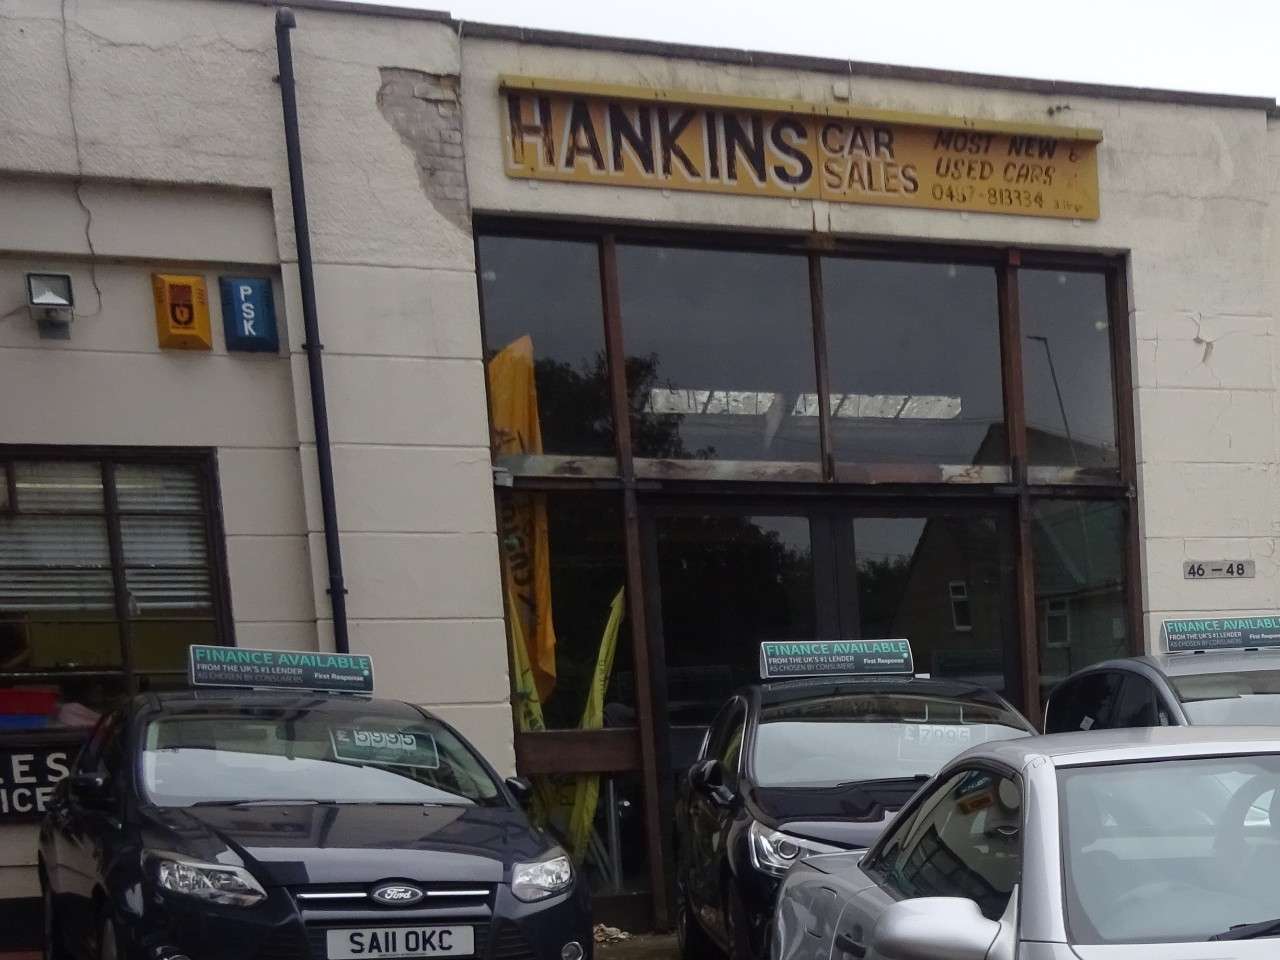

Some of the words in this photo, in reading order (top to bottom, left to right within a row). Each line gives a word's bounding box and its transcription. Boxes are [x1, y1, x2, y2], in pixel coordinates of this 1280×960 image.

[507, 93, 813, 184] HANKINS
[820, 122, 895, 160] CAR
[933, 129, 992, 156] MOST
[1007, 135, 1058, 160] NEW
[823, 158, 920, 195] SALES
[935, 156, 995, 182] USED
[1003, 161, 1056, 187] CARS
[1187, 564, 1205, 576] 46
[1226, 564, 1245, 576] 48
[1168, 621, 1221, 632] FINANCE
[195, 649, 273, 664] FINANCE
[279, 653, 369, 670] AVAILABLE
[767, 644, 830, 656] FINANCE
[833, 641, 906, 653] AVAILABLE
[197, 663, 220, 671] FROM
[271, 667, 303, 675] LENDER
[768, 657, 788, 665] FROM
[789, 656, 802, 664] THE
[803, 655, 818, 663] UK'S
[828, 655, 854, 663] LENDER
[0, 753, 70, 783] ES
[385, 888, 412, 899] Ford
[350, 931, 397, 954] SA11
[405, 930, 453, 952] OKC
